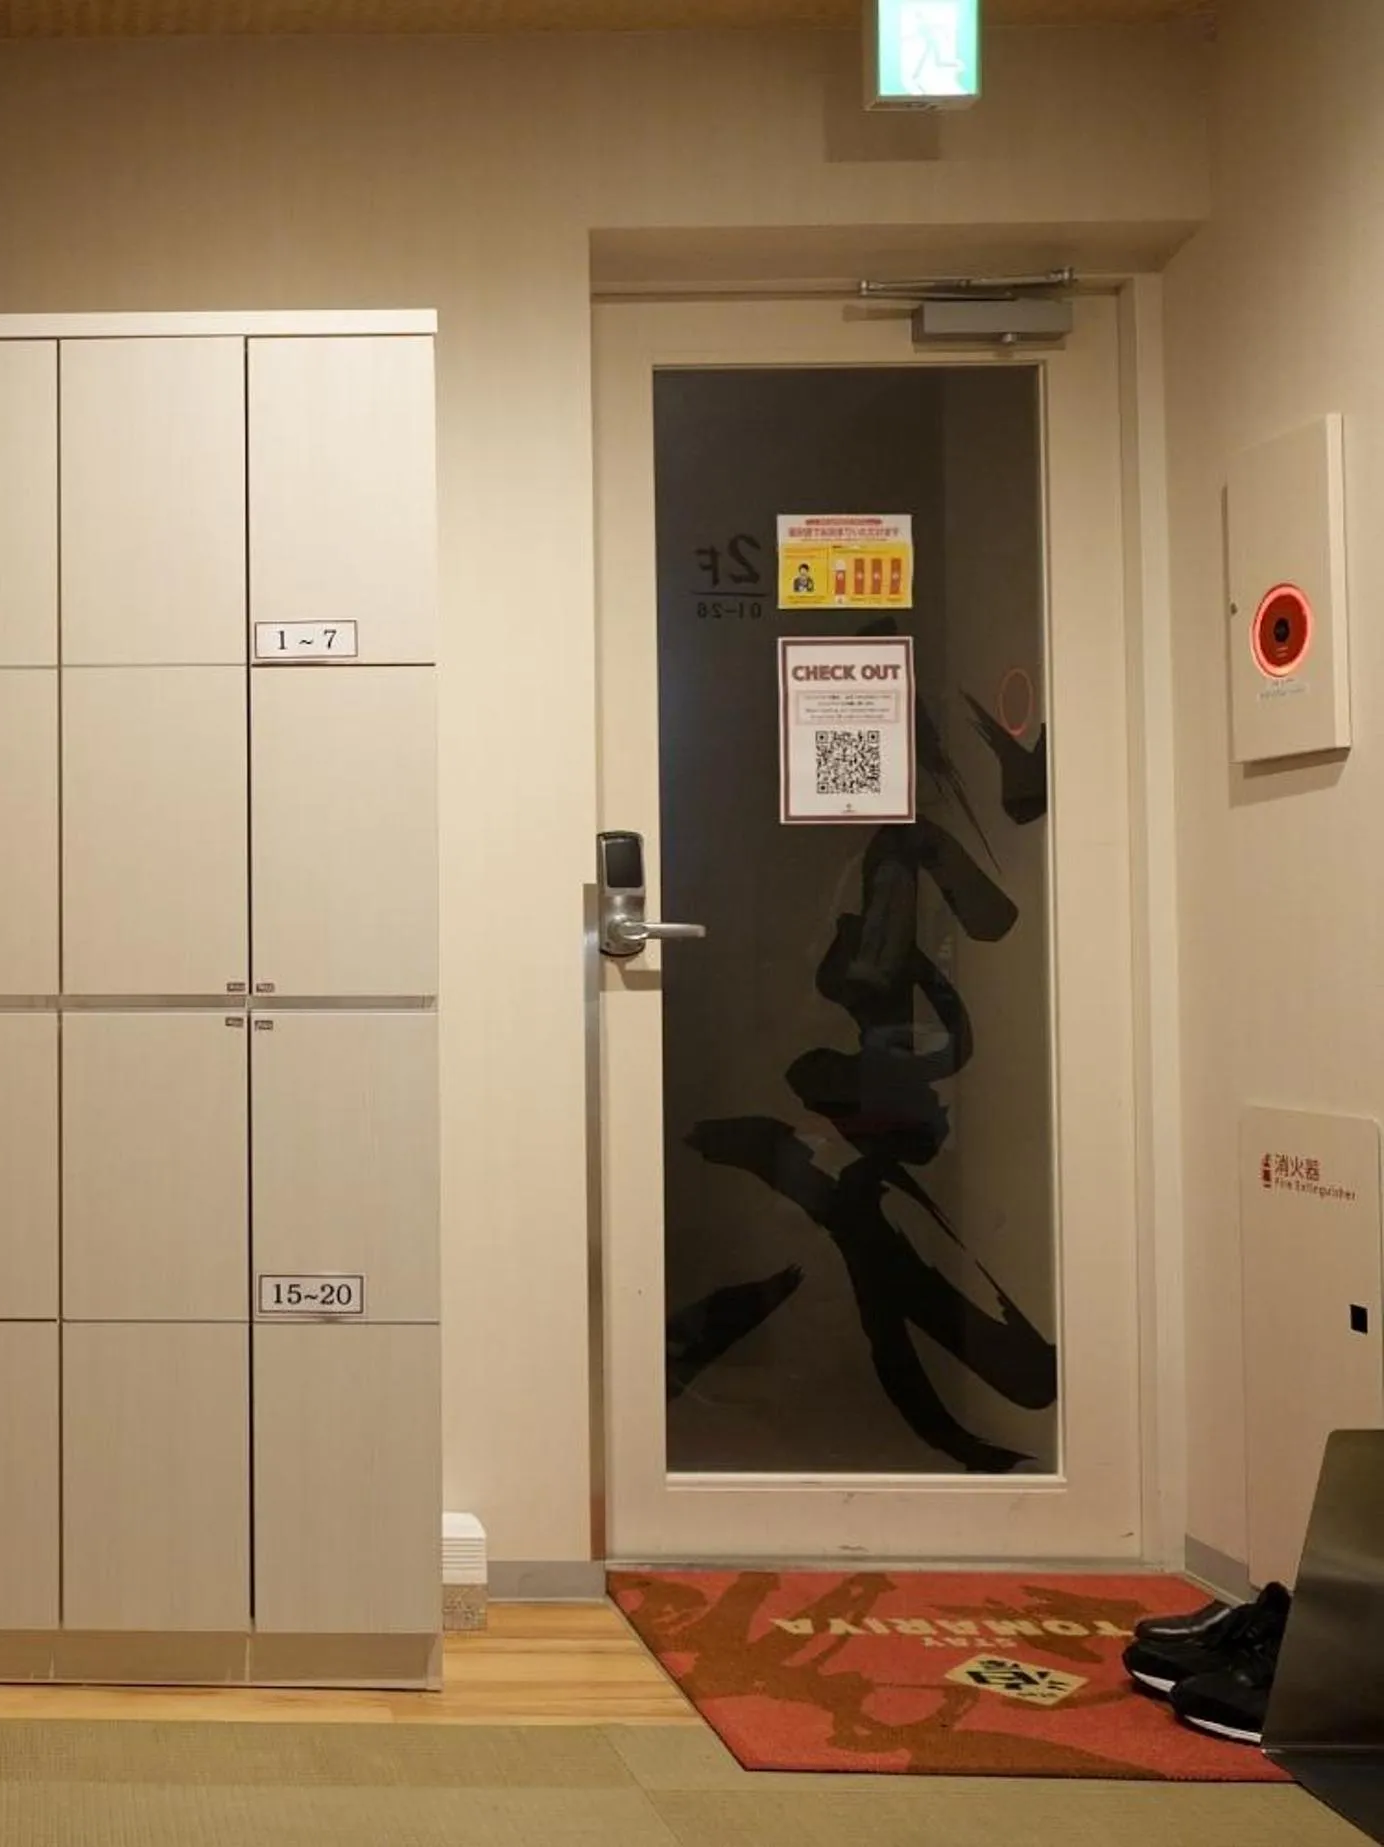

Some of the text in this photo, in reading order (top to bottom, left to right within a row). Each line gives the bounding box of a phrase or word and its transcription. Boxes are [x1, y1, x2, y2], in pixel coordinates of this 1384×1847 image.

[791, 664, 902, 681] CHECK OUT
[1274, 1153, 1320, 1181] 消火器
[274, 1284, 352, 1305] 15~20
[768, 1617, 1135, 1637] TOMARIYA
[921, 1636, 1017, 1648] STAY
